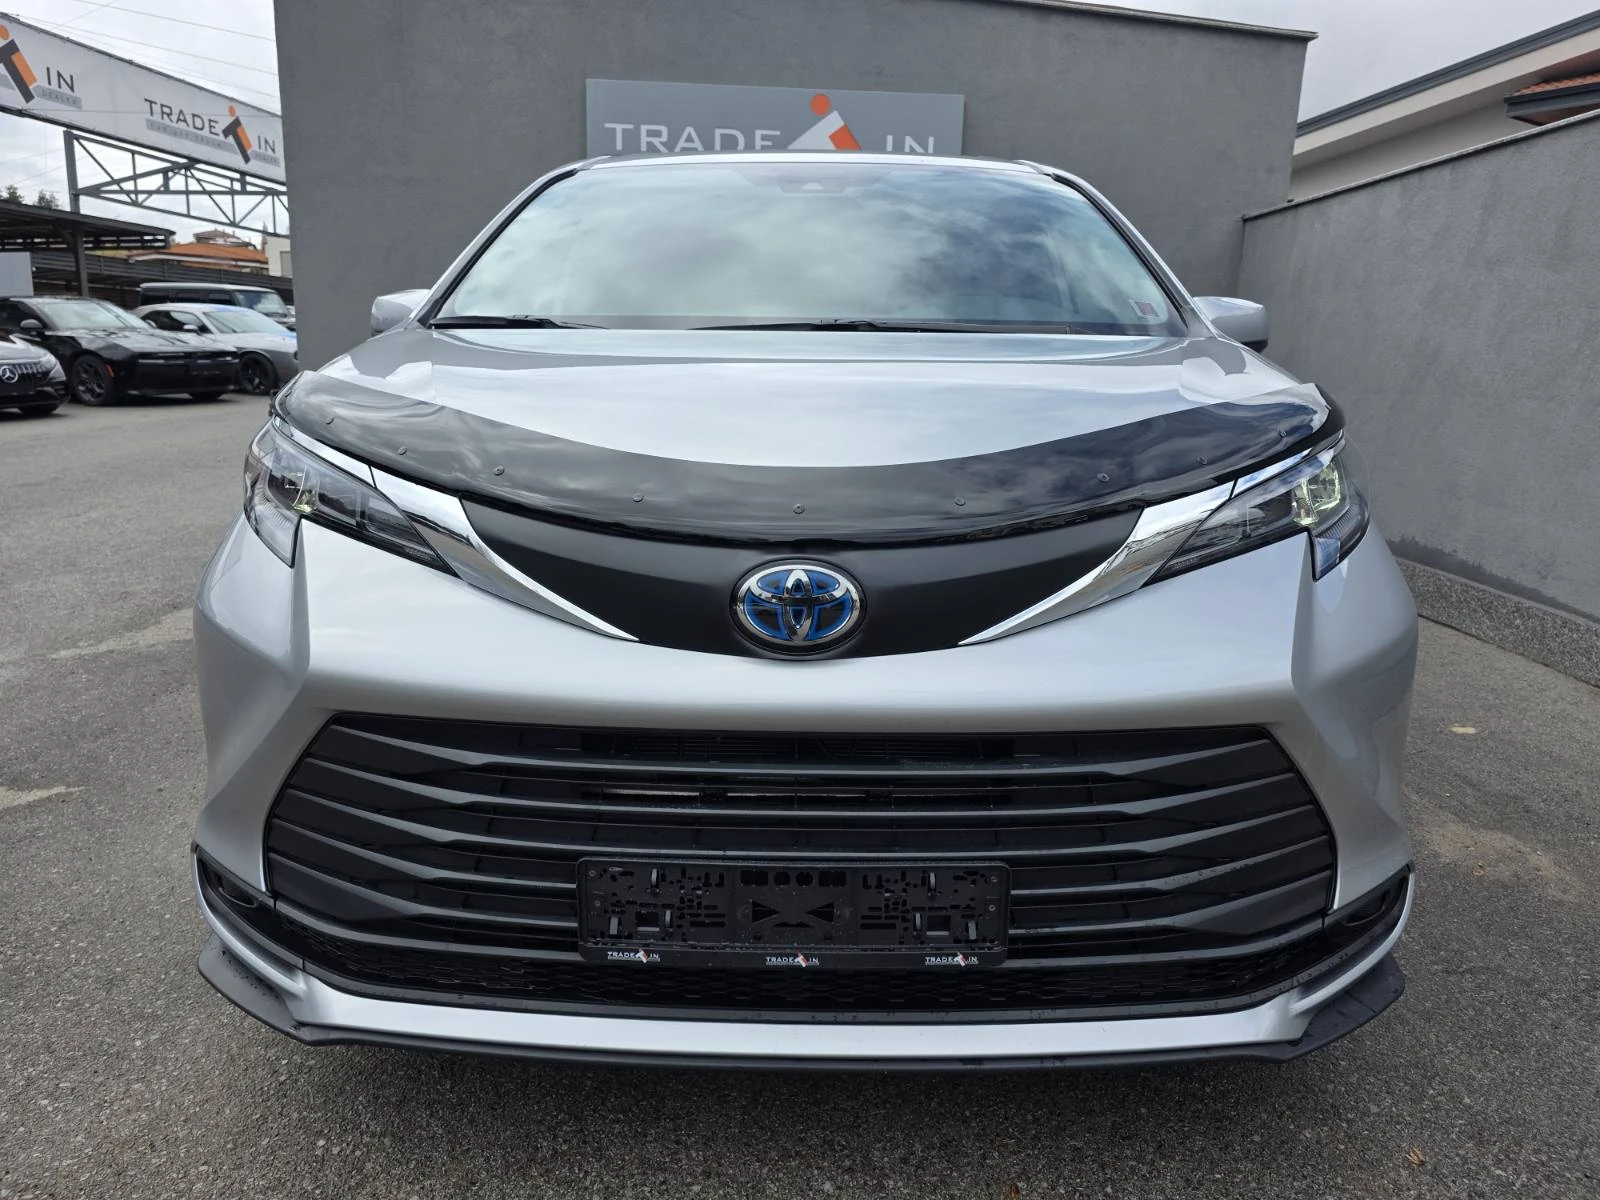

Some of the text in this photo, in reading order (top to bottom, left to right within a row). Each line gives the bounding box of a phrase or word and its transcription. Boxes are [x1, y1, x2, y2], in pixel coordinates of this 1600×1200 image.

[46, 66, 75, 94] IN
[144, 97, 220, 137] TRADE
[257, 135, 276, 154] IN
[604, 122, 935, 154] TRADE IN
[607, 951, 636, 959] TRADE
[765, 956, 795, 964] TRADE
[924, 956, 954, 964] TRADE
